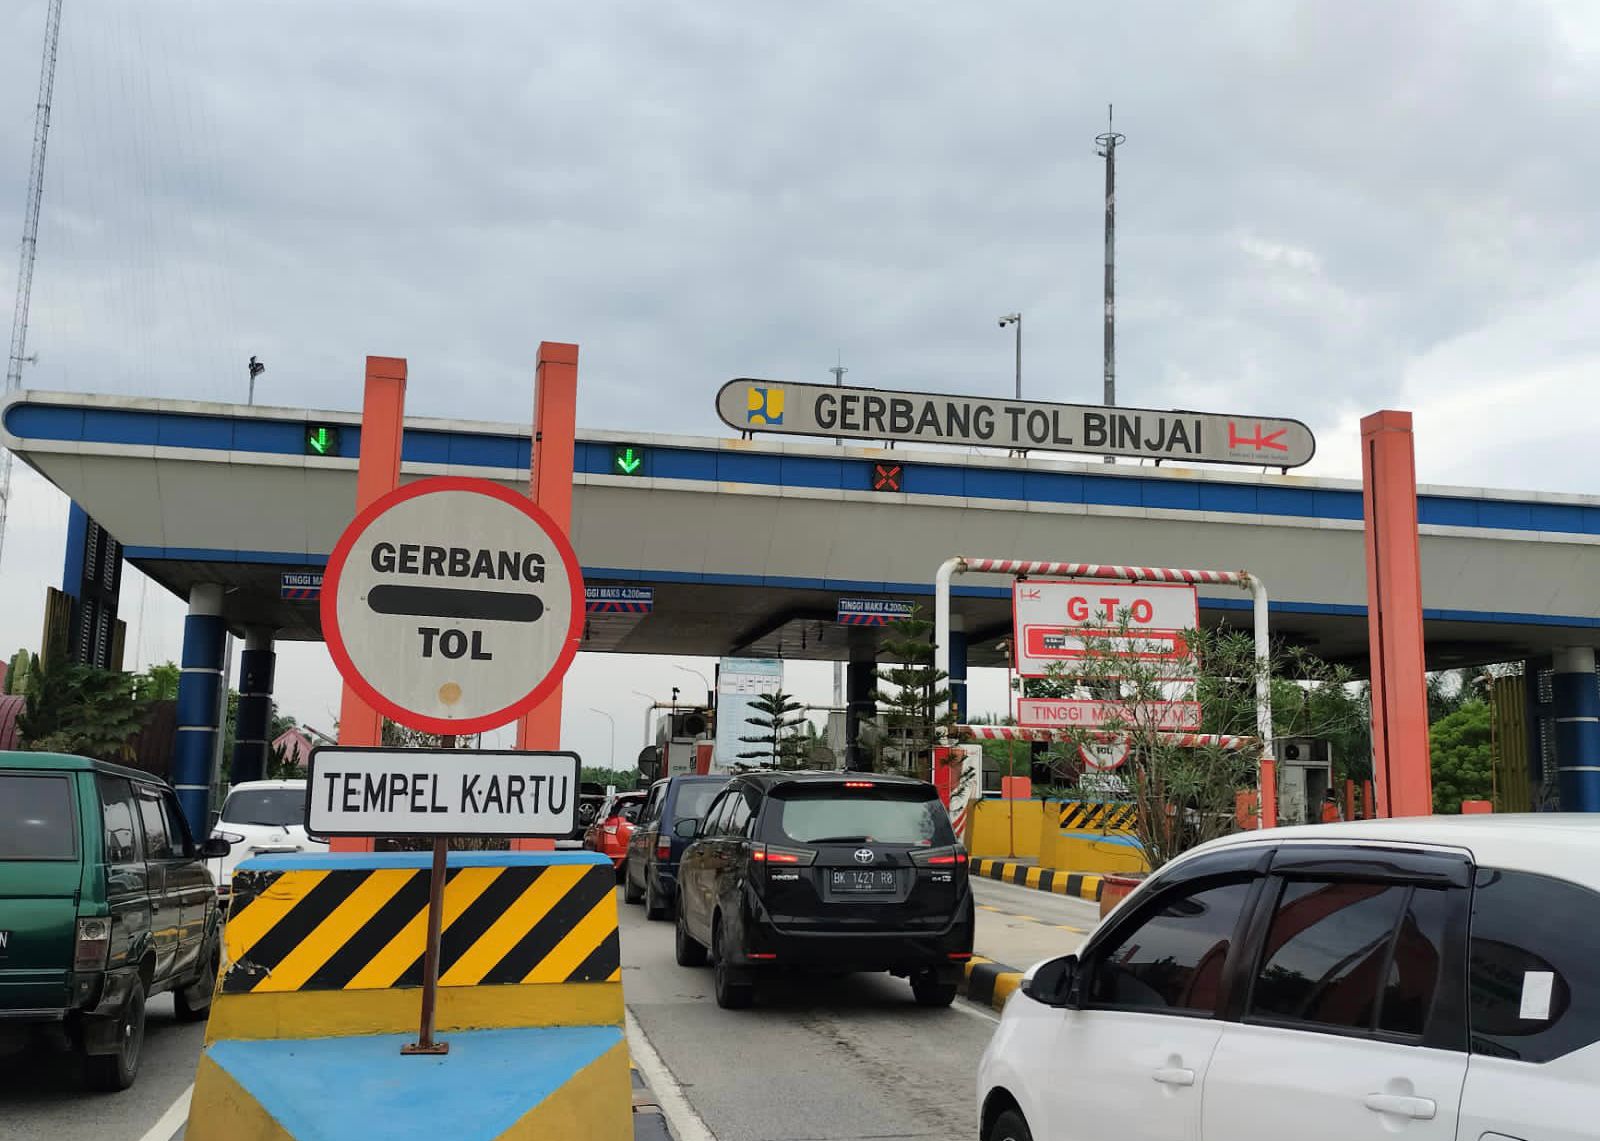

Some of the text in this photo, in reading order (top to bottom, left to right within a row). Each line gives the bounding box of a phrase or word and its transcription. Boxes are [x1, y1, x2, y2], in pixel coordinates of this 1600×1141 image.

[815, 394, 1202, 454] GERBANG TOL BINJAI
[371, 542, 545, 583] GERBANG
[284, 575, 311, 585] TINGGI
[600, 588, 620, 598] MAKS
[840, 600, 864, 611] TINGGI
[864, 602, 883, 612] MAKS
[1067, 596, 1153, 624] GTO
[418, 627, 492, 661] TOL
[1032, 705, 1083, 721] TINGGI
[323, 772, 567, 815] TEMPEL KARTU
[833, 871, 846, 885] BK
[853, 871, 874, 885] 1427
